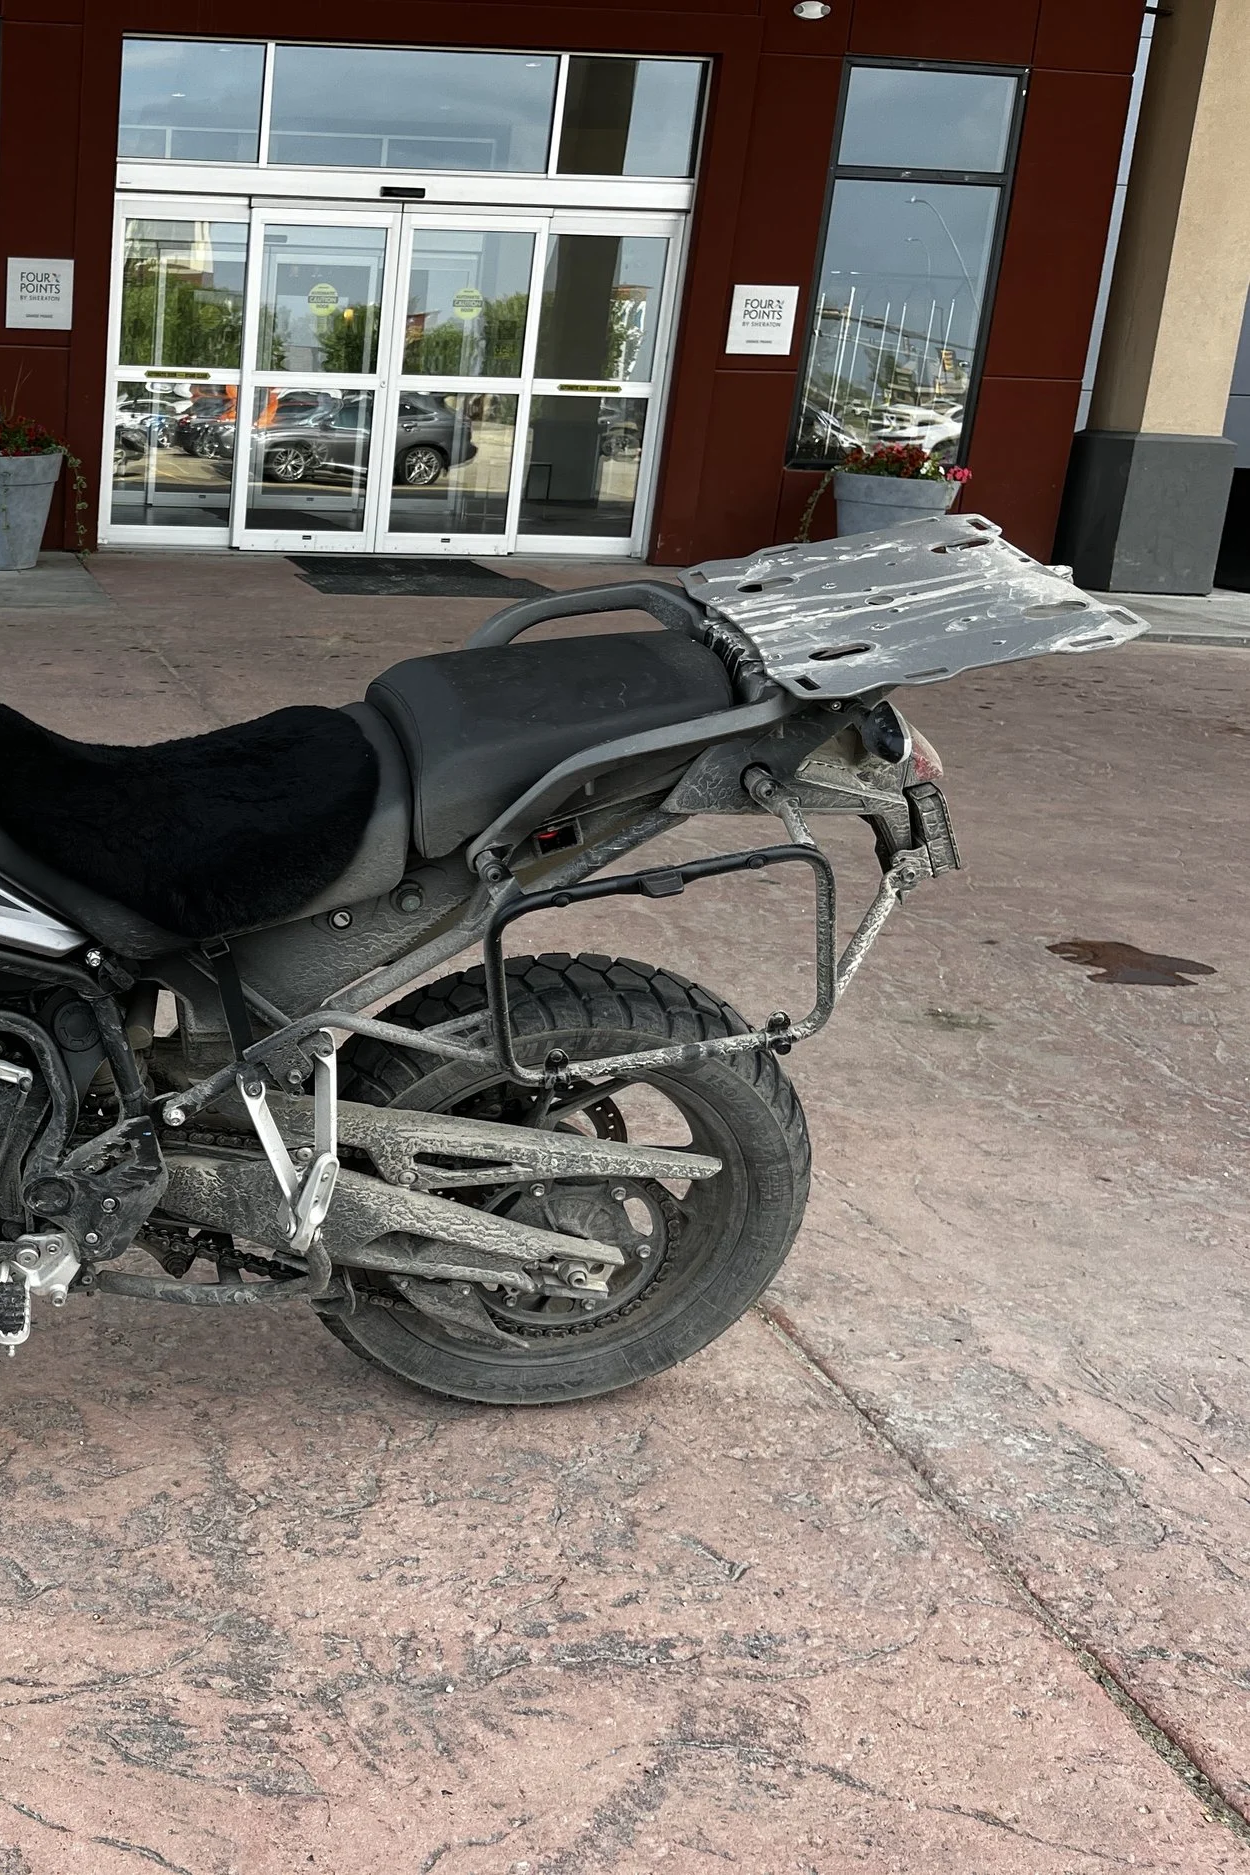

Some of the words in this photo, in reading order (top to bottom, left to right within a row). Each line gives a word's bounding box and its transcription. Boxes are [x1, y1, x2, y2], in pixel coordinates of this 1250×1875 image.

[20, 272, 50, 282] FOUR
[20, 283, 60, 294] POINTS
[744, 299, 774, 309] FOUR
[743, 310, 782, 320] POINTS
